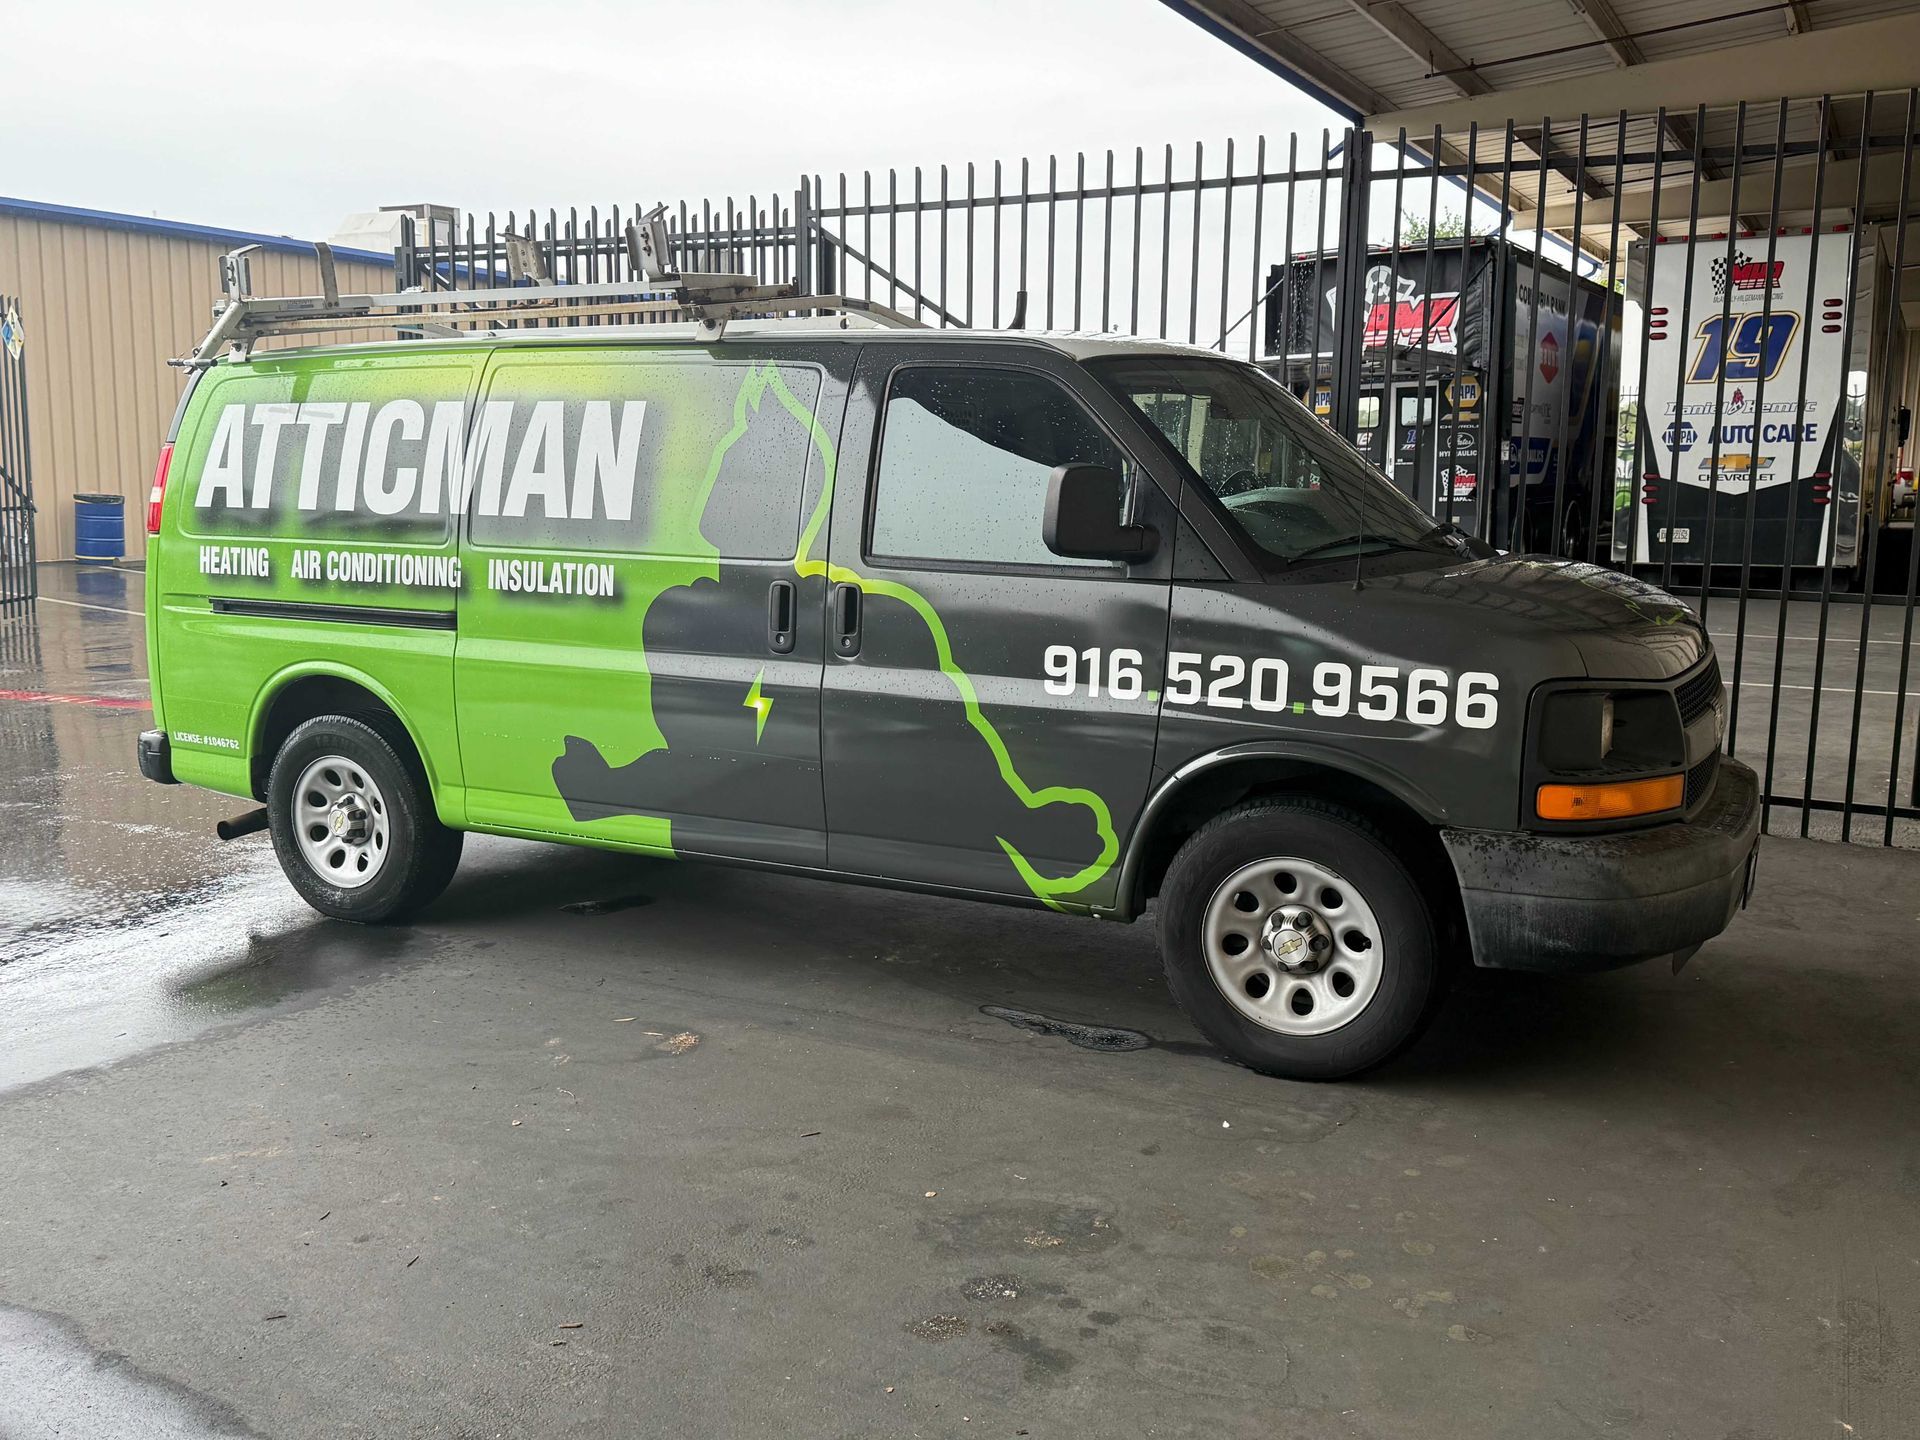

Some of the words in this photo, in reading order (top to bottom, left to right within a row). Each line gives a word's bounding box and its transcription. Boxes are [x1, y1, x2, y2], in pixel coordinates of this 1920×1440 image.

[1686, 310, 1801, 384] 19
[1451, 384, 1476, 399] APA
[1742, 400, 1818, 414] Hemrc
[1667, 430, 1693, 444] NPA
[195, 399, 646, 522] ATTICMAN
[199, 545, 270, 578] HEATING
[291, 549, 321, 580] AIR
[326, 551, 462, 588] CONDITIONING
[488, 559, 615, 597] INSULATION
[1043, 644, 1499, 729] 916.520.9566
